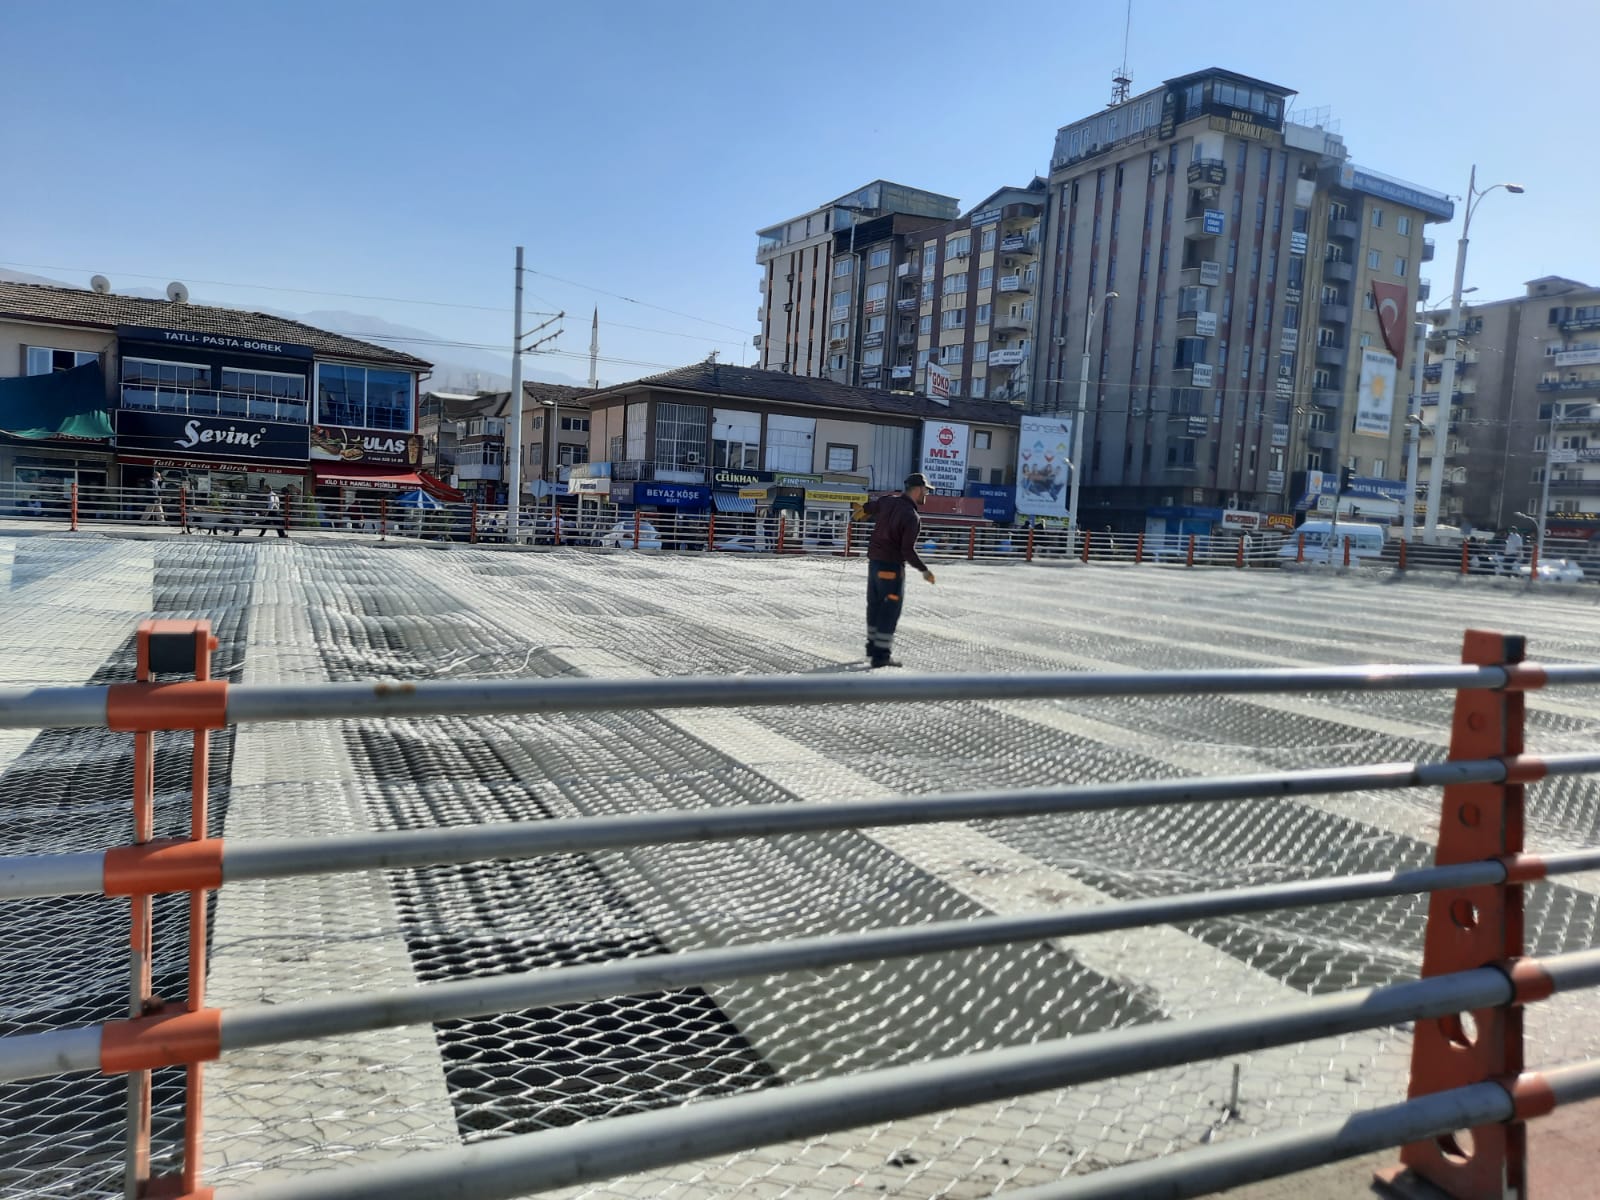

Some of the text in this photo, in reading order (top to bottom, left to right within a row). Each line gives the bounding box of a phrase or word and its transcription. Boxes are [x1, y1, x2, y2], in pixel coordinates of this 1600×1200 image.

[363, 437, 406, 455] ULAŞ
[930, 448, 960, 460] MLT
[646, 488, 700, 501] BEYAZ KÖŞE
